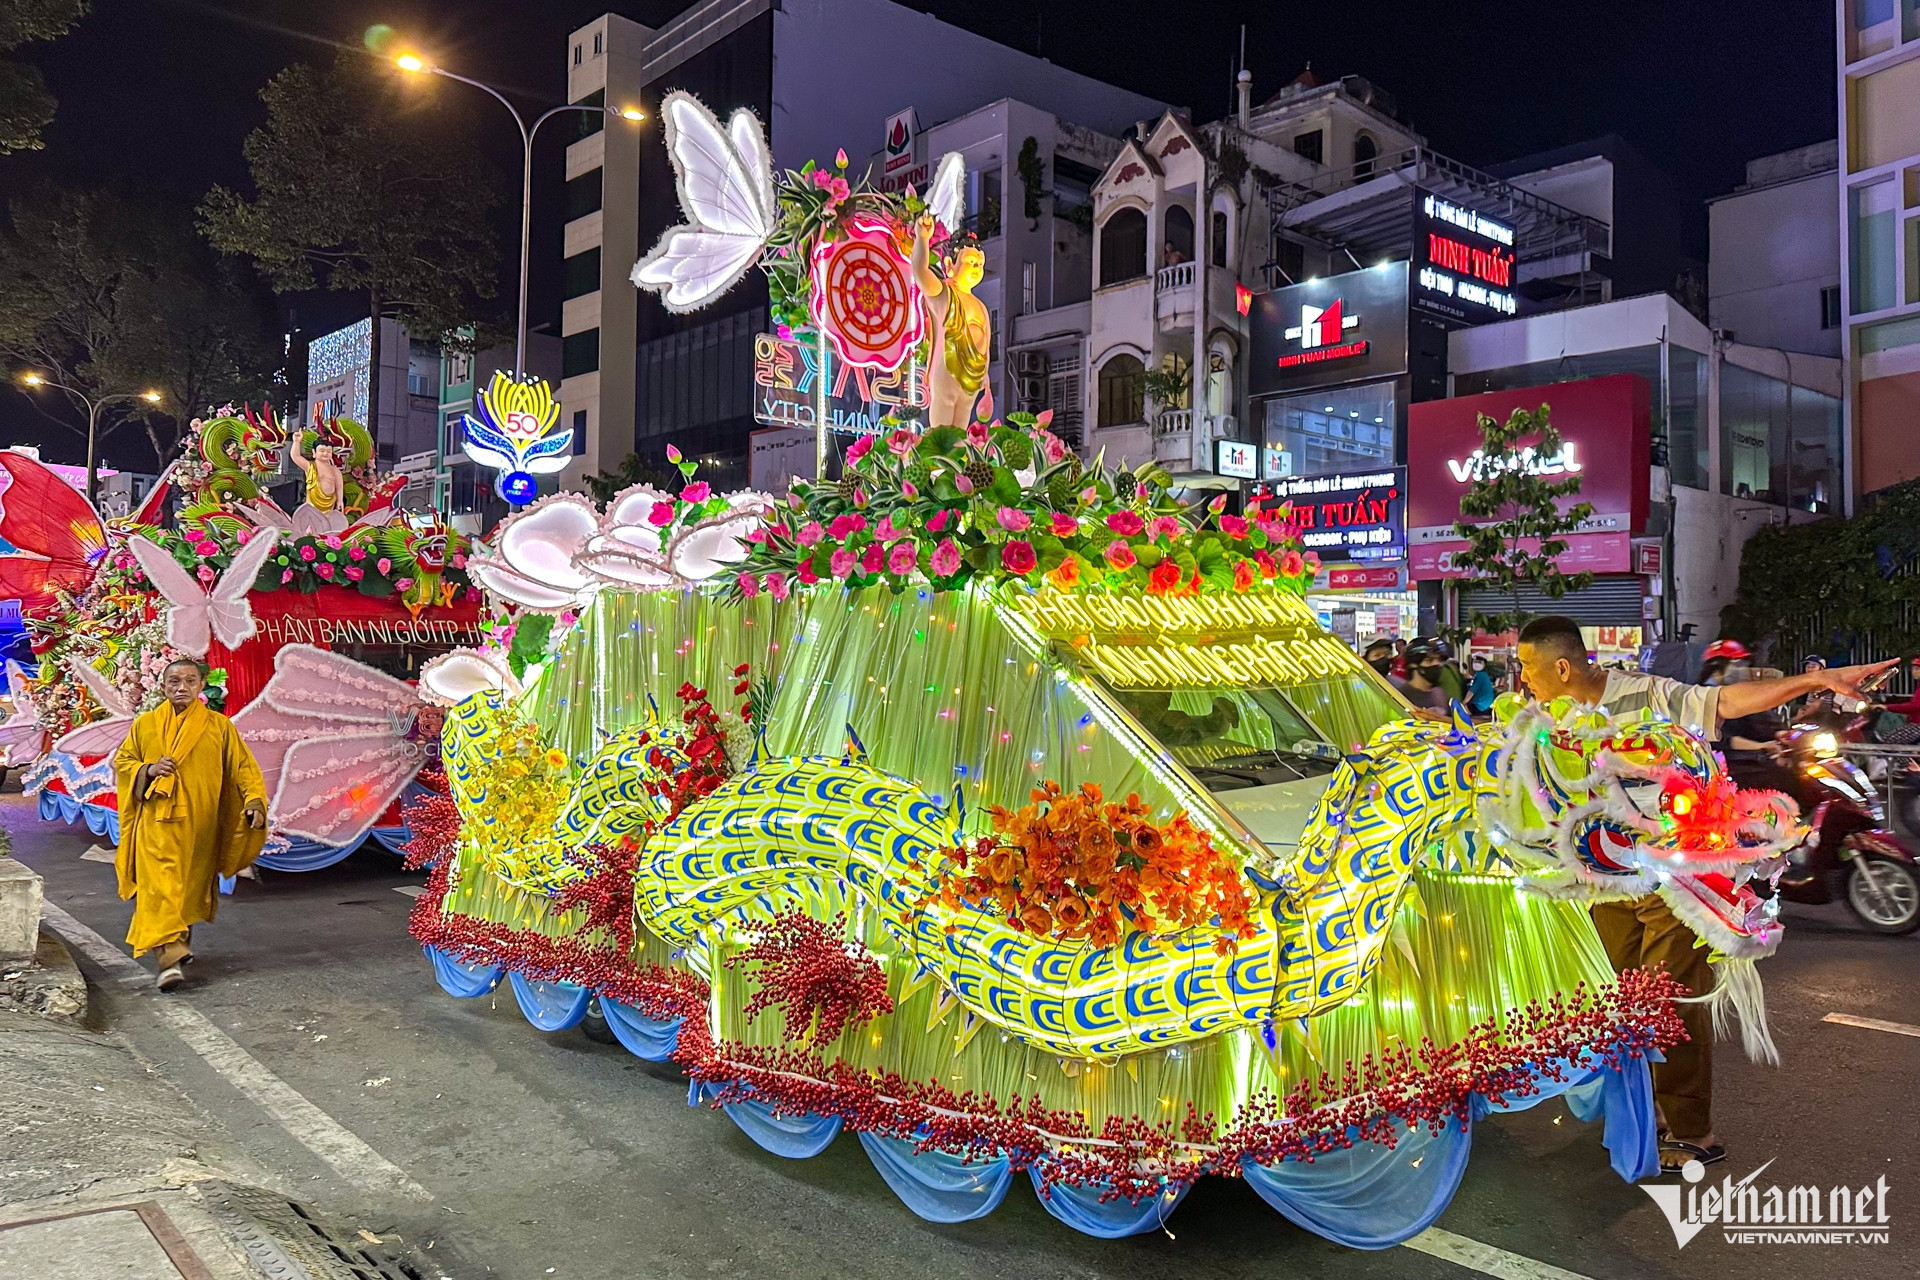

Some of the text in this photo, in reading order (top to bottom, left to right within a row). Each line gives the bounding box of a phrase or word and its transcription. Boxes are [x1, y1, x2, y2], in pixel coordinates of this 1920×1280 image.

[1429, 233, 1510, 287] MINH TUẤN
[1278, 354, 1301, 368] MINH
[1302, 350, 1325, 364] TUAN
[507, 413, 539, 435] 50
[1276, 481, 1288, 497] HỆ
[1313, 477, 1330, 493] BÁN
[1341, 473, 1395, 490] SMARTPHONE
[1321, 489, 1388, 527] TUẤN
[1349, 531, 1368, 546] PHỤ
[1369, 527, 1392, 544] KIỆN
[1016, 586, 1095, 631] PHẬT
[1085, 587, 1150, 630] GIÁO
[256, 613, 315, 643] PHÂN
[318, 618, 366, 644] BAN
[394, 613, 438, 644] GIỚI
[1080, 632, 1170, 687] KÍNH
[1228, 634, 1309, 687] PHẬT
[1288, 626, 1364, 680] ĐẢN
